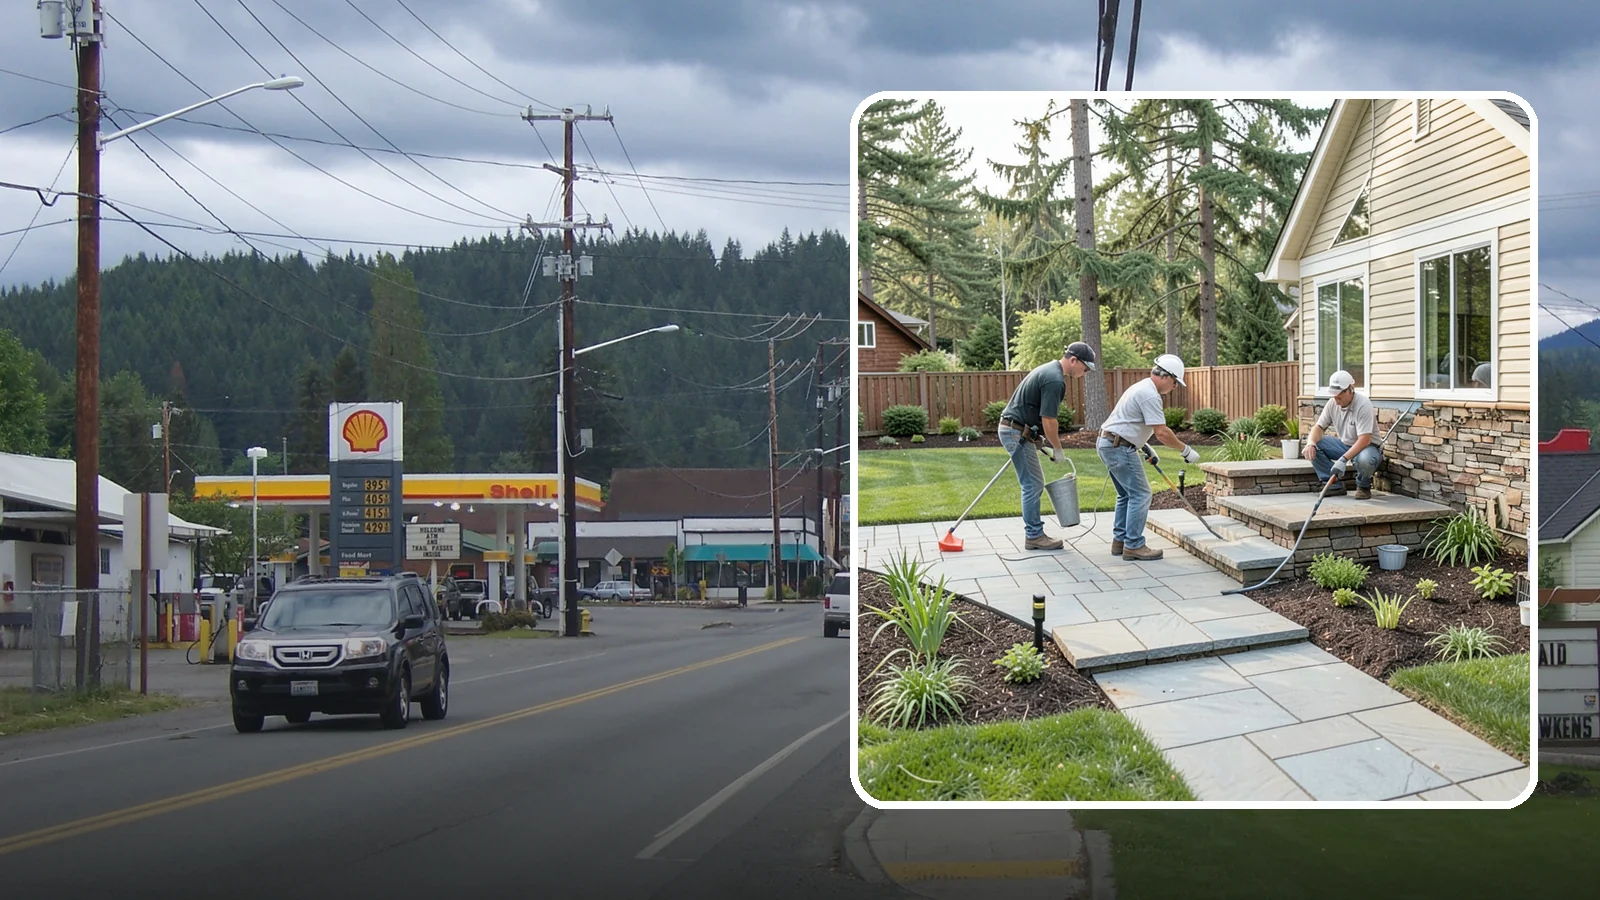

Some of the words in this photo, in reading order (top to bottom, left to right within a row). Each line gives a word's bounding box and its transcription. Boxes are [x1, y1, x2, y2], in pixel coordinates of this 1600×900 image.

[365, 480, 384, 490] 395
[490, 484, 547, 499] Shell
[365, 494, 384, 504] 405
[365, 508, 384, 518] 415
[365, 522, 384, 532] 429
